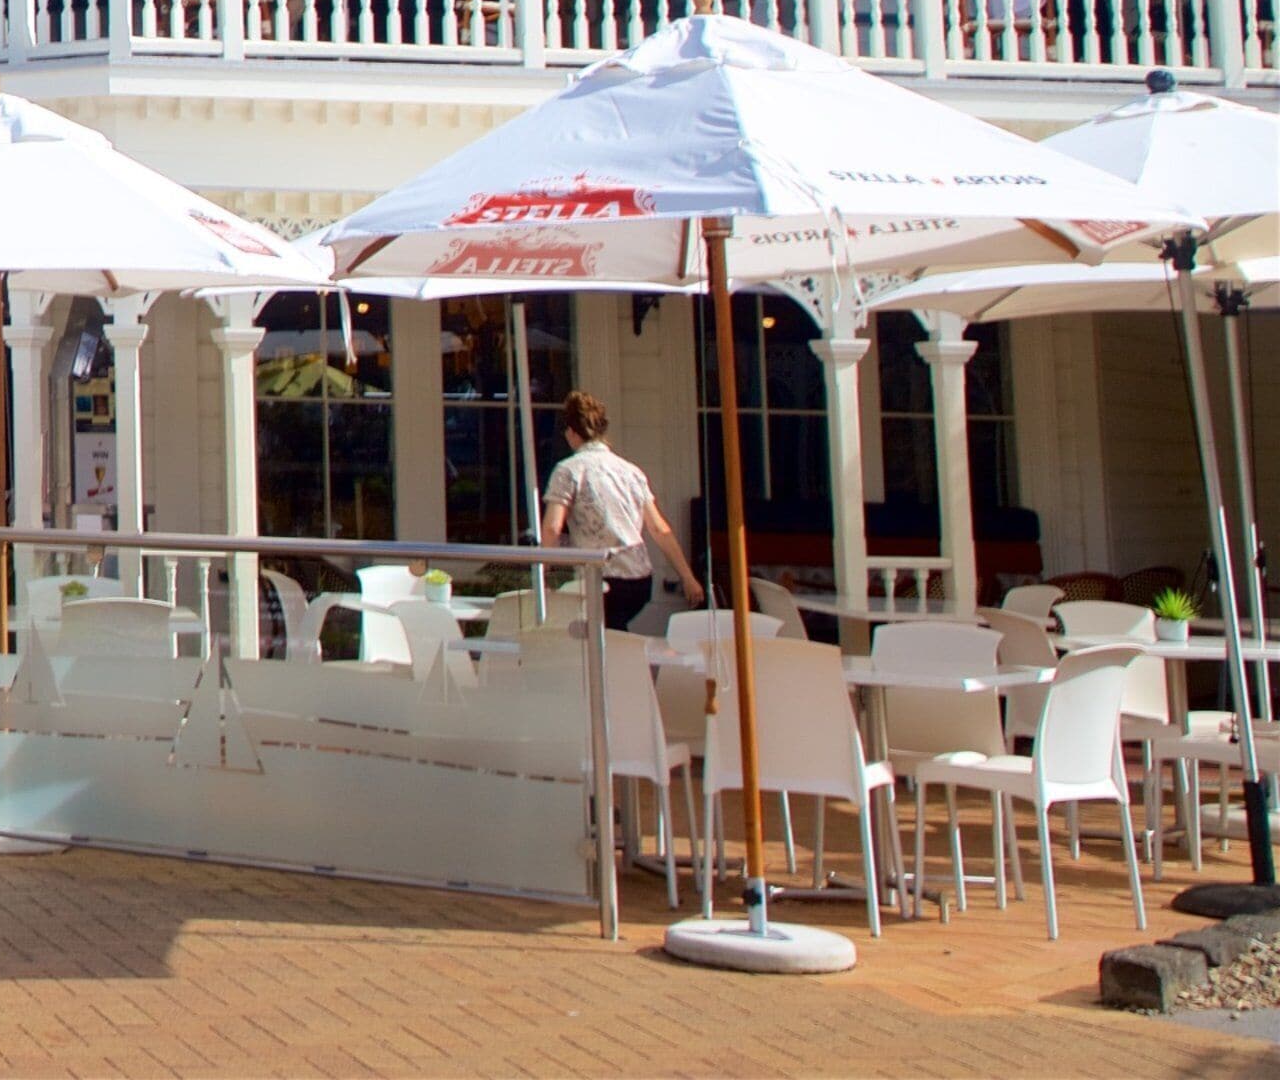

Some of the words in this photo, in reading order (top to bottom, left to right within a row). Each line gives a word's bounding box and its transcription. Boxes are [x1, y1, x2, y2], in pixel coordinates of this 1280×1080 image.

[828, 170, 924, 185] STELLA
[954, 175, 1048, 186] ARTOIS
[477, 201, 622, 221] STELLA
